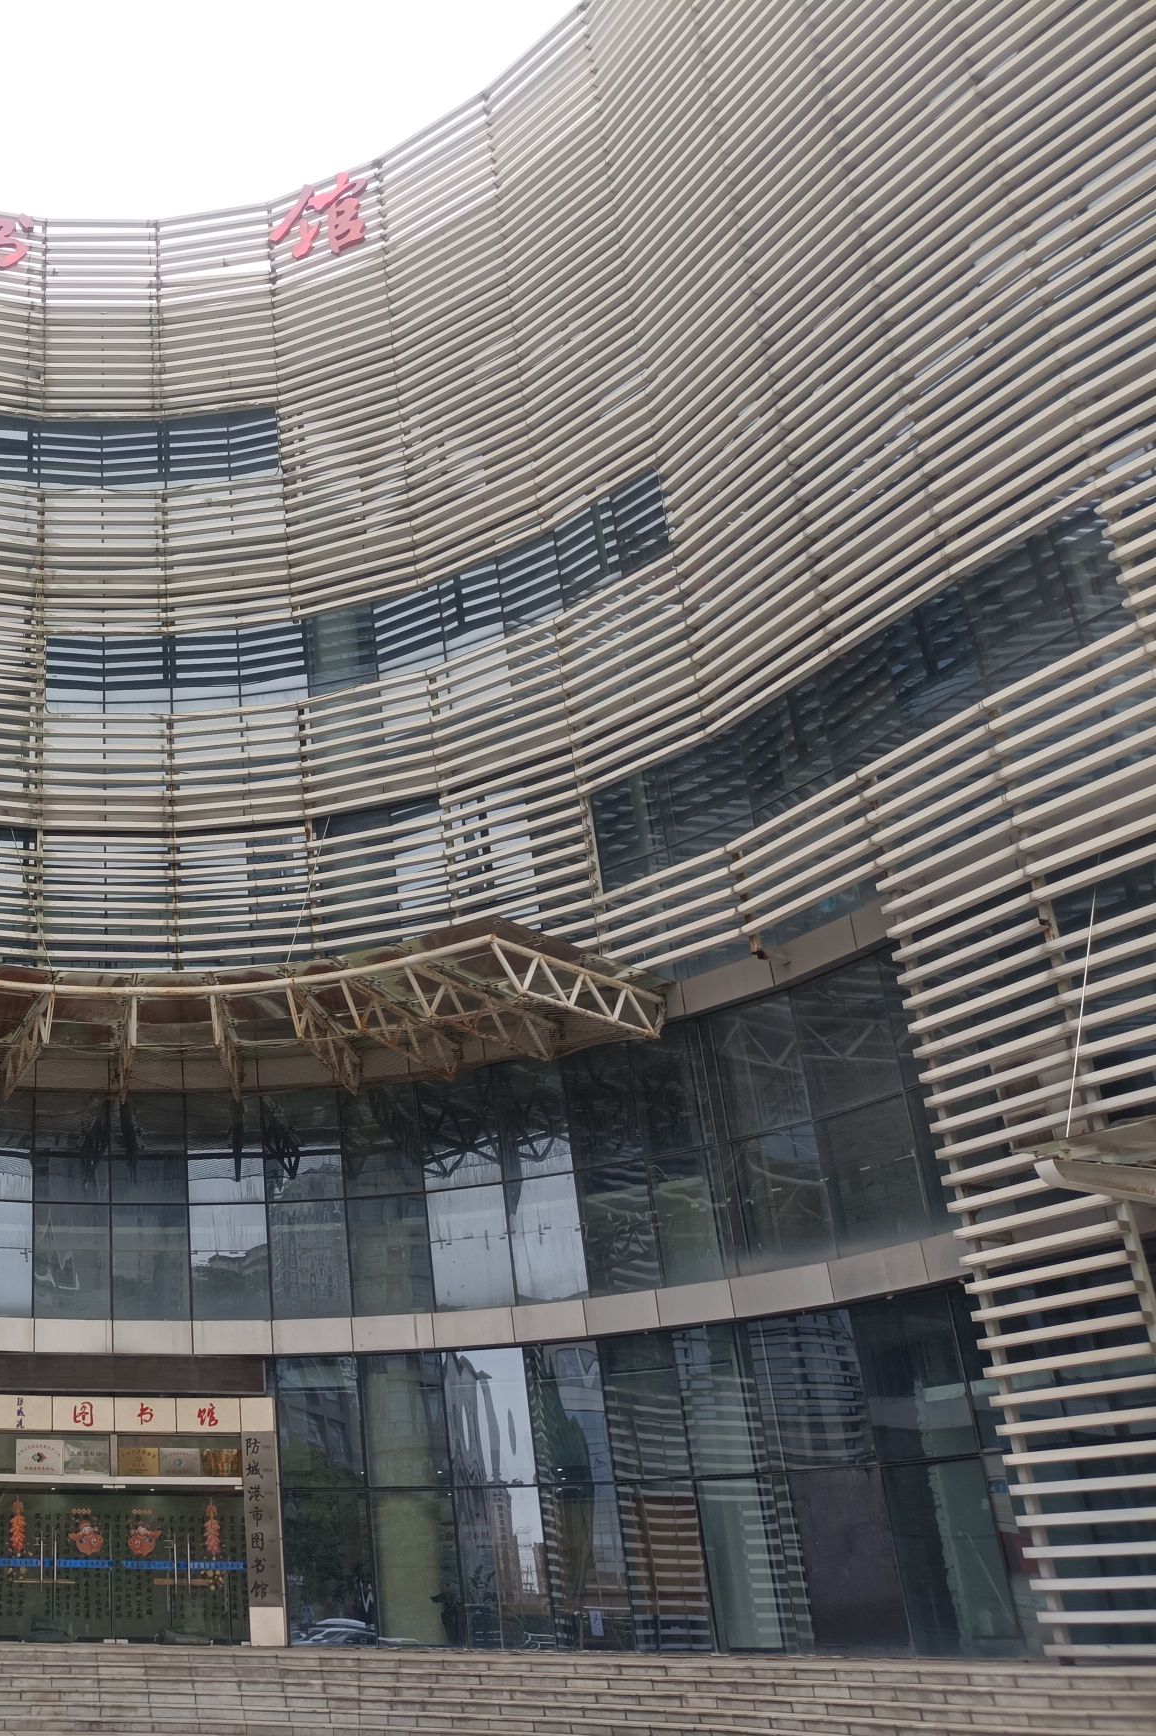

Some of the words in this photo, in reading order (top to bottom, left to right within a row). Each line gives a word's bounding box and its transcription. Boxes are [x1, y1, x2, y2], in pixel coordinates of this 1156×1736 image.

[73, 1401, 218, 1427] 图书馆
[245, 1437, 268, 1600] 防城港市图书馆
